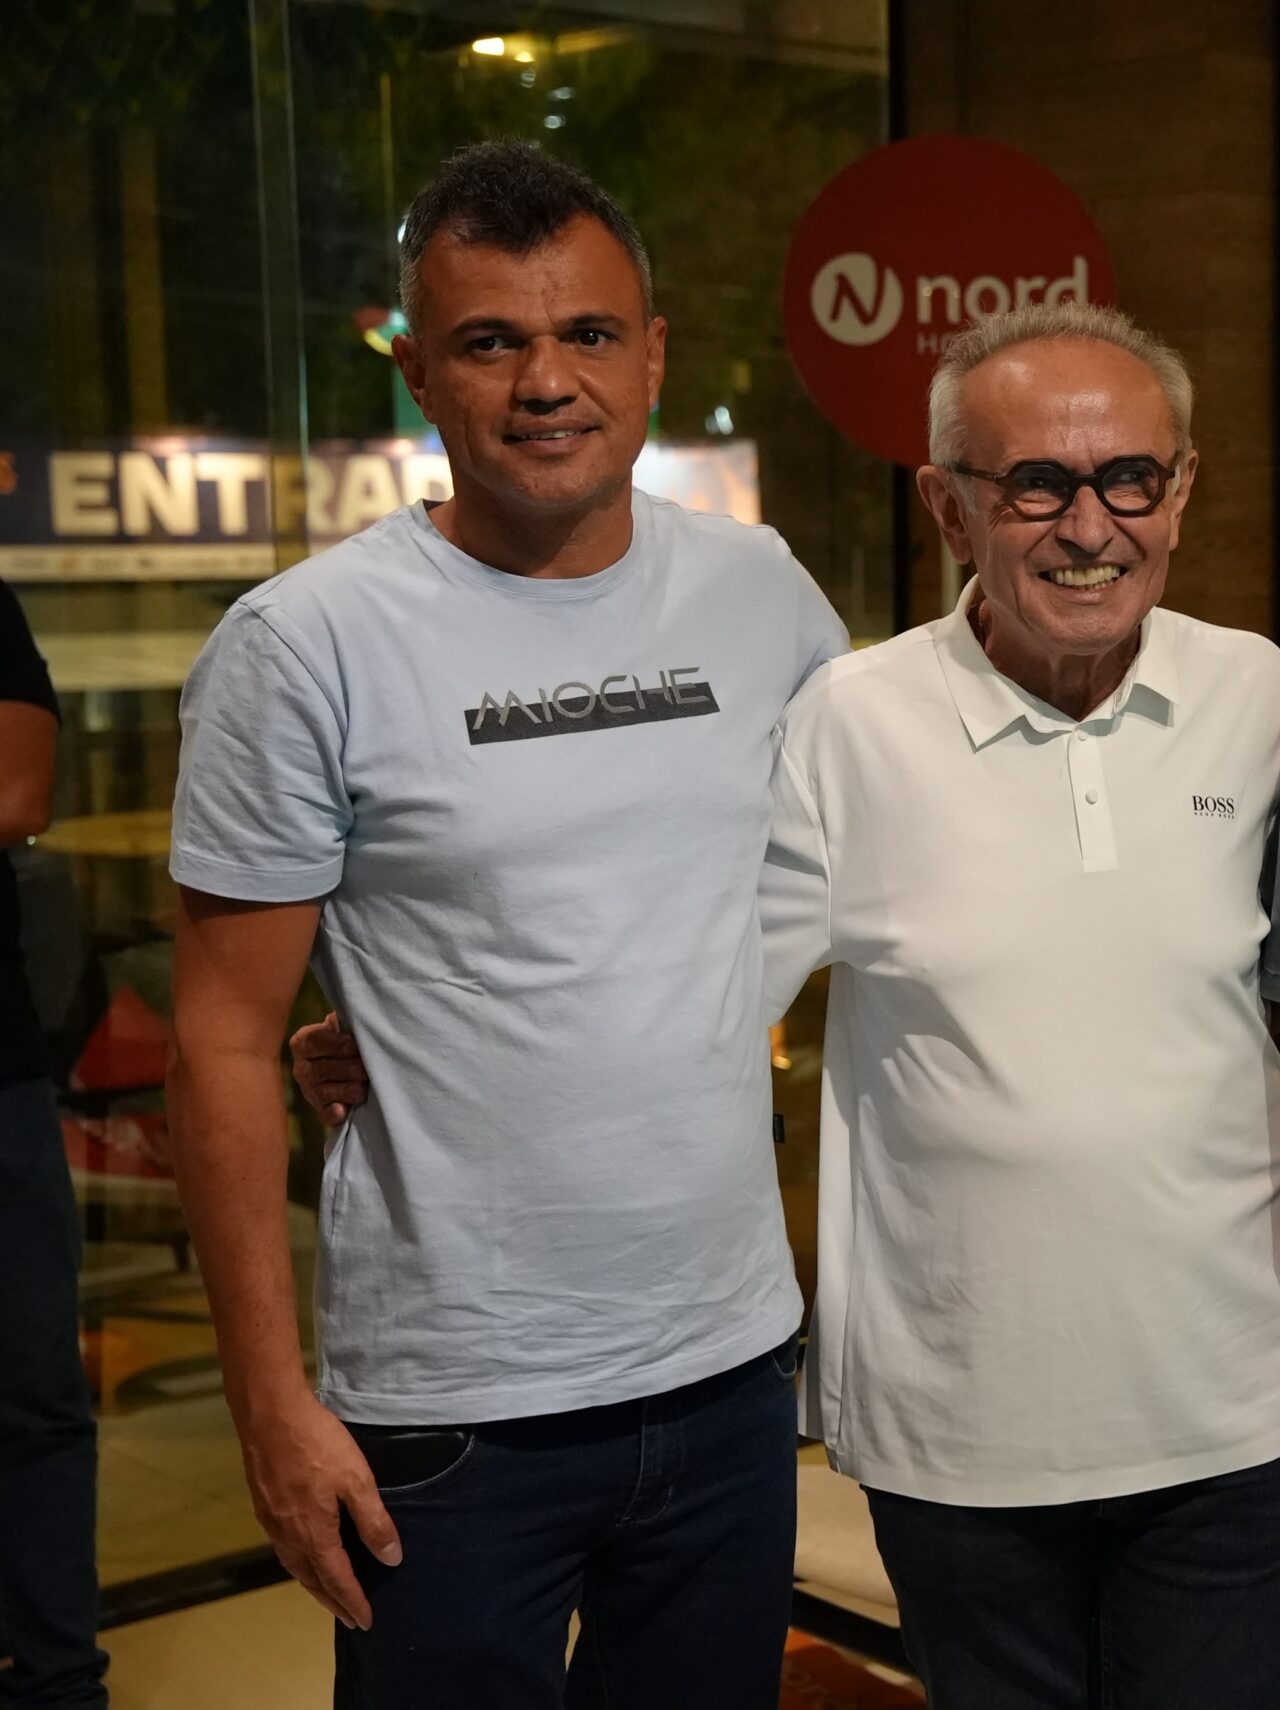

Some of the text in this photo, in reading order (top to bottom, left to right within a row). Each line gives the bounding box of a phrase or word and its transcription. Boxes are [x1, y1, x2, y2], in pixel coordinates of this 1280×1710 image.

[916, 256, 1088, 324] nord
[472, 667, 710, 731] MIOCHE
[1191, 795, 1235, 815] BOSS
